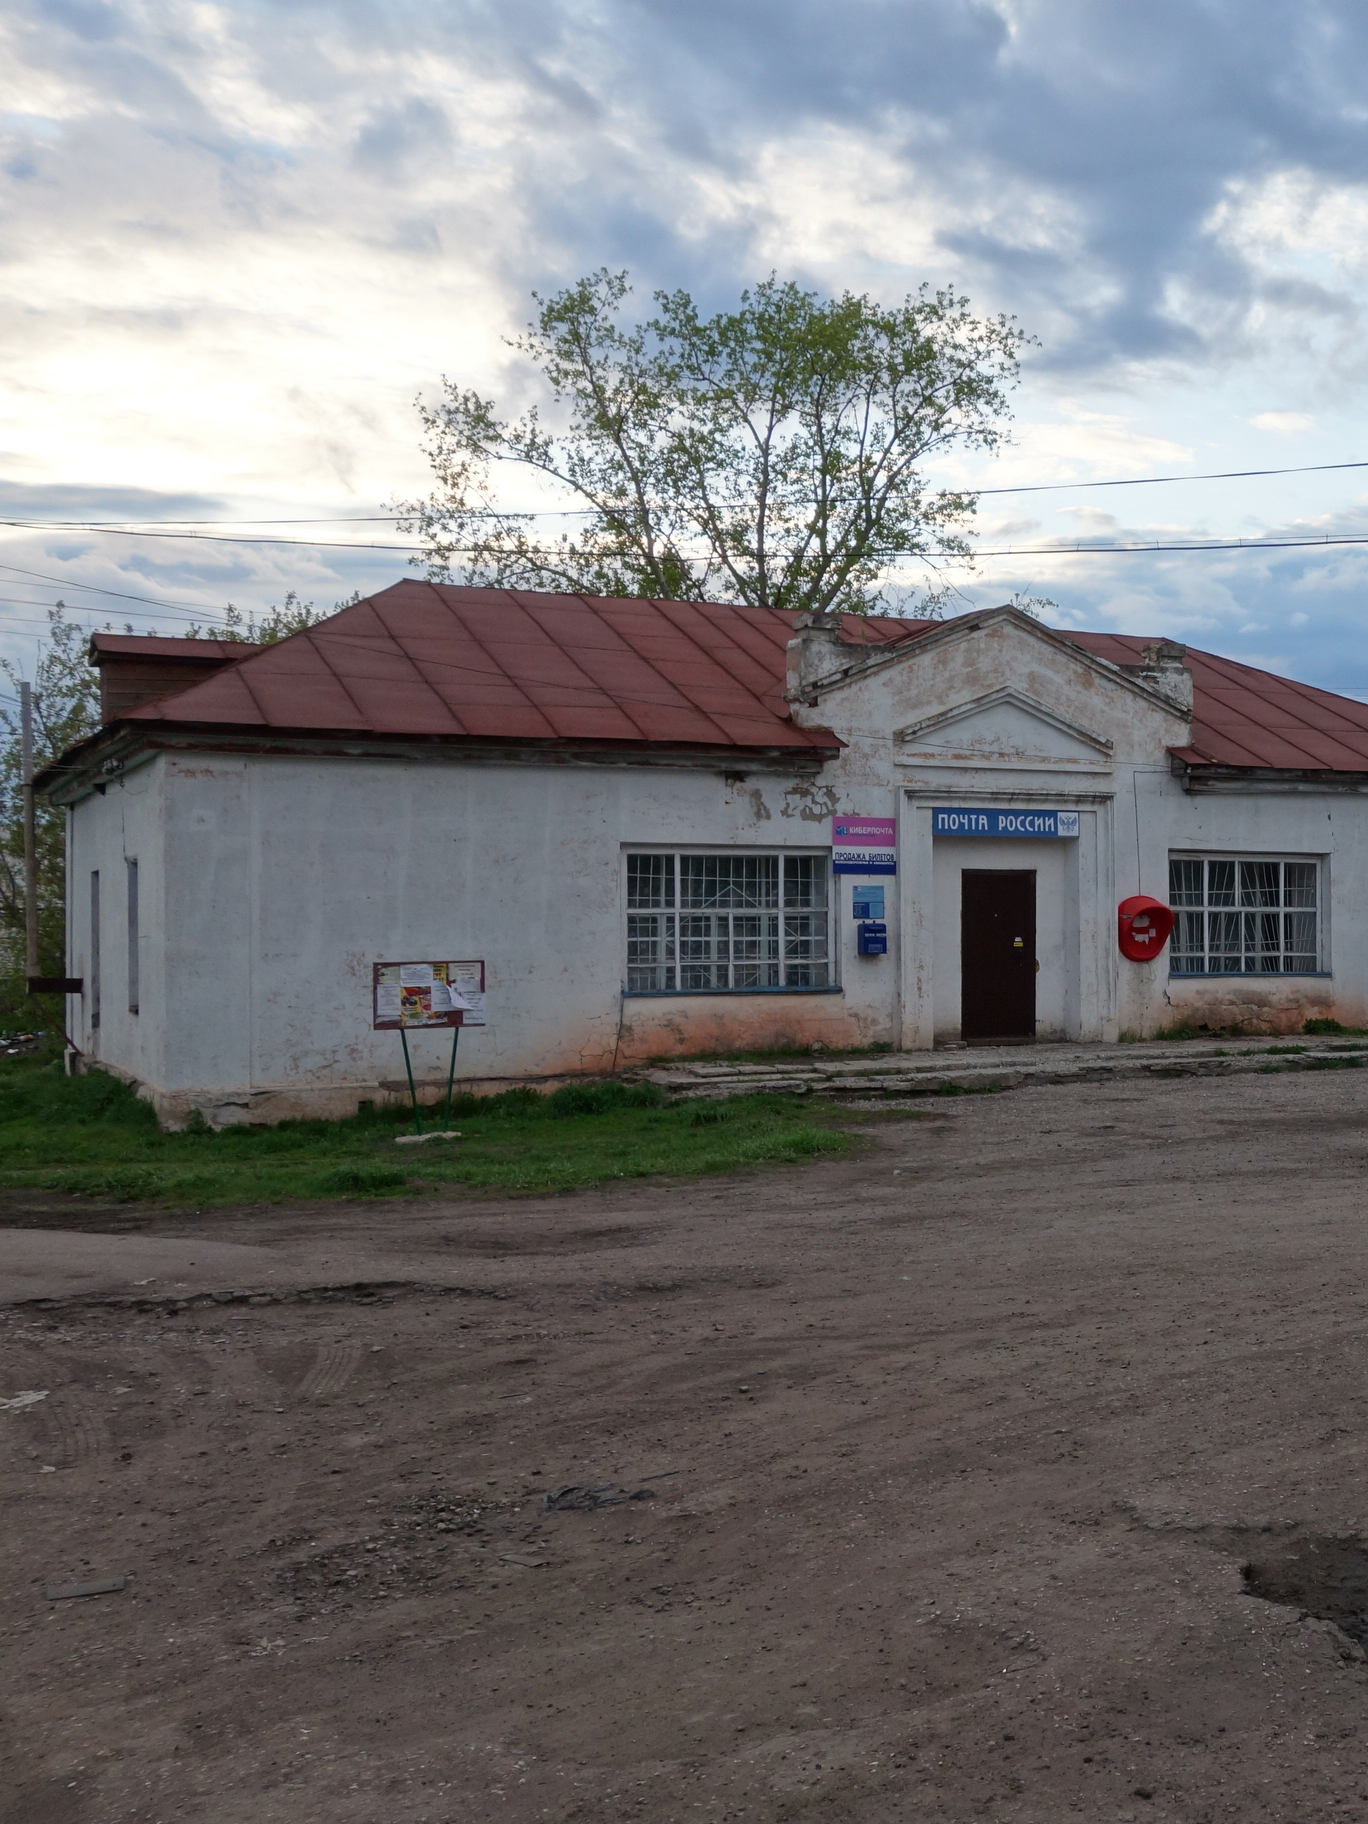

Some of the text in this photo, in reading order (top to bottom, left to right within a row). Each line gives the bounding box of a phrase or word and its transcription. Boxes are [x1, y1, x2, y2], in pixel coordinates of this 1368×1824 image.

[938, 813, 1055, 832] ПОЧТА РОССИИ
[849, 826, 894, 835] КИБЕРПОЧТА
[834, 852, 895, 862] ПРОДАЖА БИЛЕТОВ
